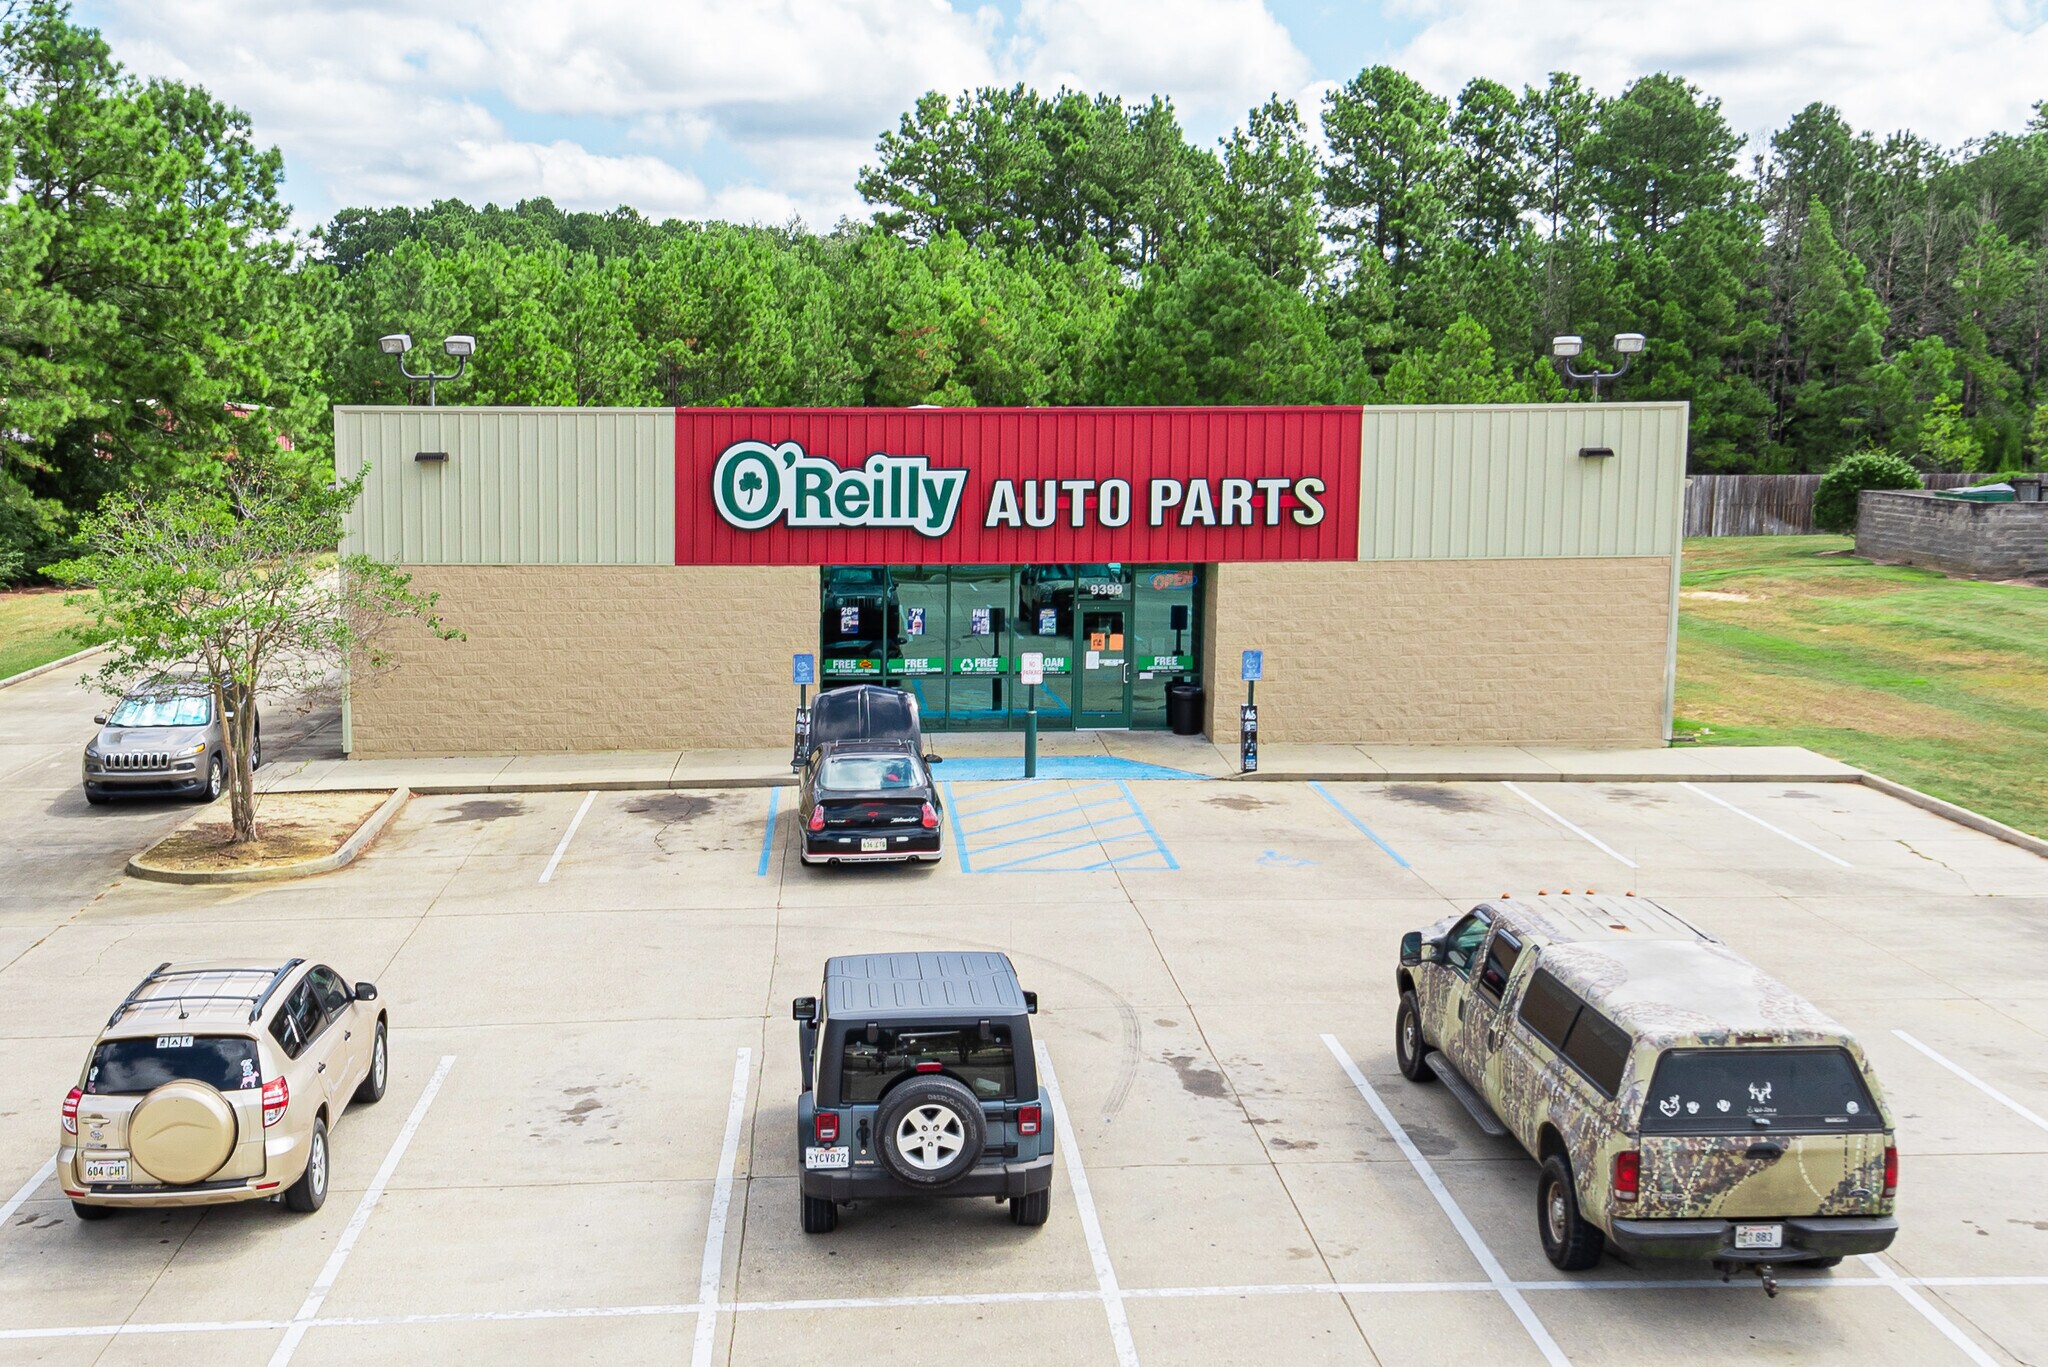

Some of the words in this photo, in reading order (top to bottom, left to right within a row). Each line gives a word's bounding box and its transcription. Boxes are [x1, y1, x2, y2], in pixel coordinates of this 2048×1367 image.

[719, 447, 959, 530] O'Reilly
[984, 477, 1131, 529] AUTO
[1149, 476, 1327, 527] PARTS
[1152, 570, 1193, 591] OPEN
[1090, 584, 1123, 595] 9399
[832, 659, 857, 669] FREE
[904, 658, 928, 668] FREE
[974, 657, 999, 667] FREE
[1042, 657, 1065, 667] OAN
[1154, 656, 1178, 666] FREE
[814, 1153, 847, 1163] YCV872
[87, 1166, 104, 1176] 604
[109, 1165, 125, 1176] CHT
[1755, 1232, 1773, 1242] 883
